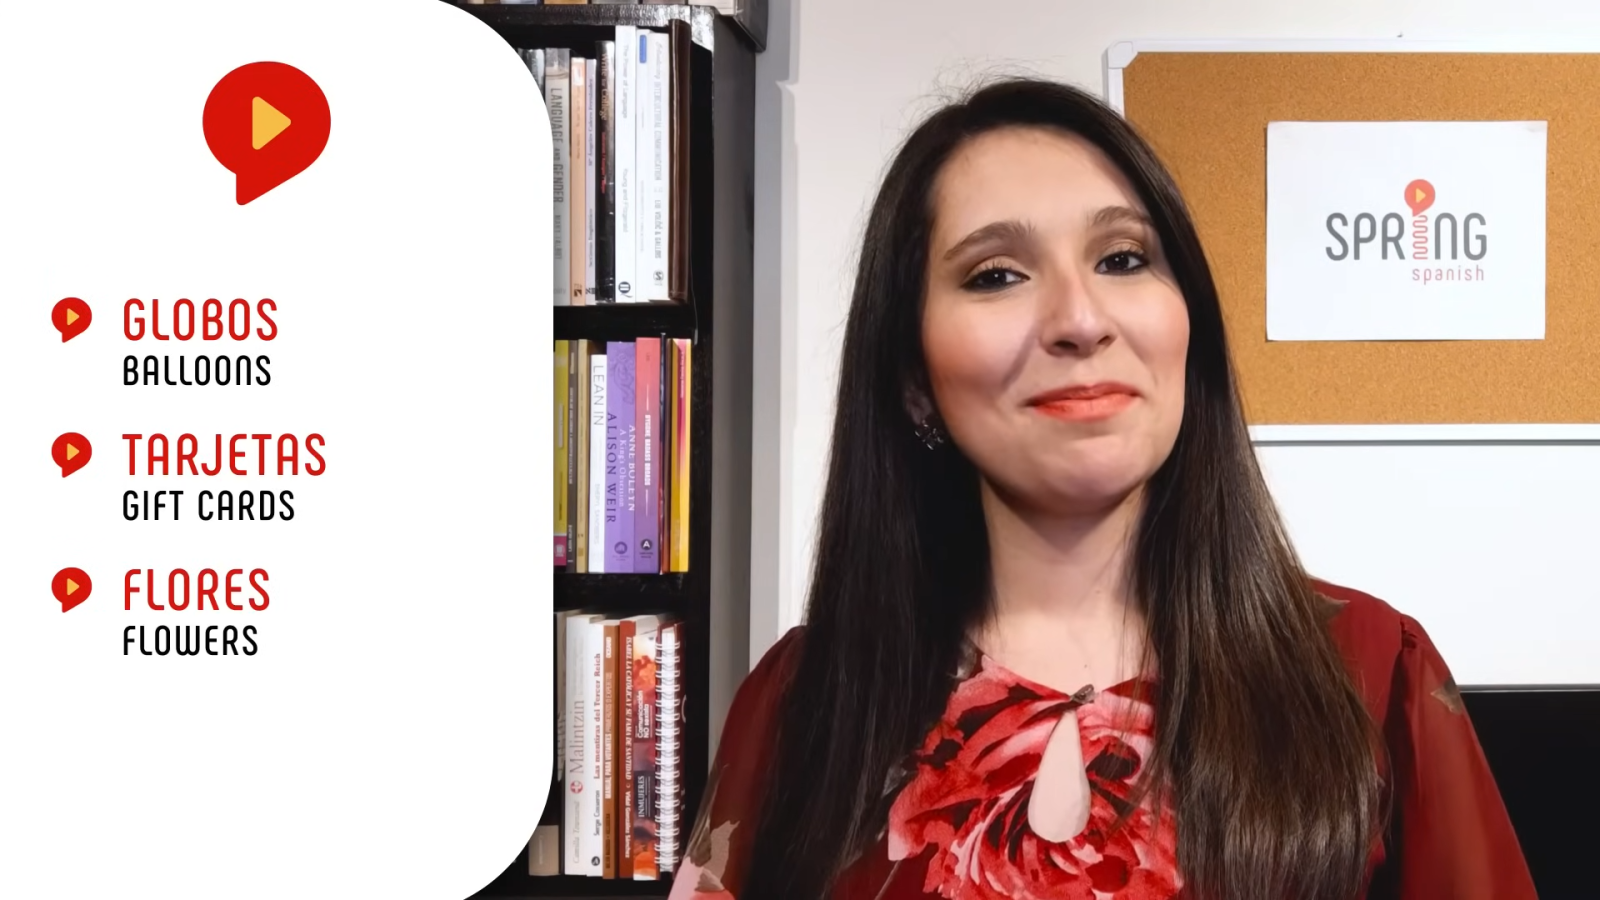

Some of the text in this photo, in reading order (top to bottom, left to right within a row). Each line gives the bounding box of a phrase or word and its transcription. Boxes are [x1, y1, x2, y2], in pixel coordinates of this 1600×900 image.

[550, 88, 562, 143] LANGUAGE
[600, 88, 608, 120] College
[553, 164, 563, 203] GENDER
[1326, 212, 1487, 261] SPRING
[1412, 264, 1485, 285] spanish
[594, 365, 604, 426] LEAN IN
[607, 412, 616, 523] ALISON WEIR
[618, 467, 626, 507] Obsession
[626, 661, 632, 670] LA
[626, 708, 632, 717] SU
[569, 700, 585, 774] Malintzin
[626, 737, 632, 746] DE
[644, 727, 649, 738] NO
